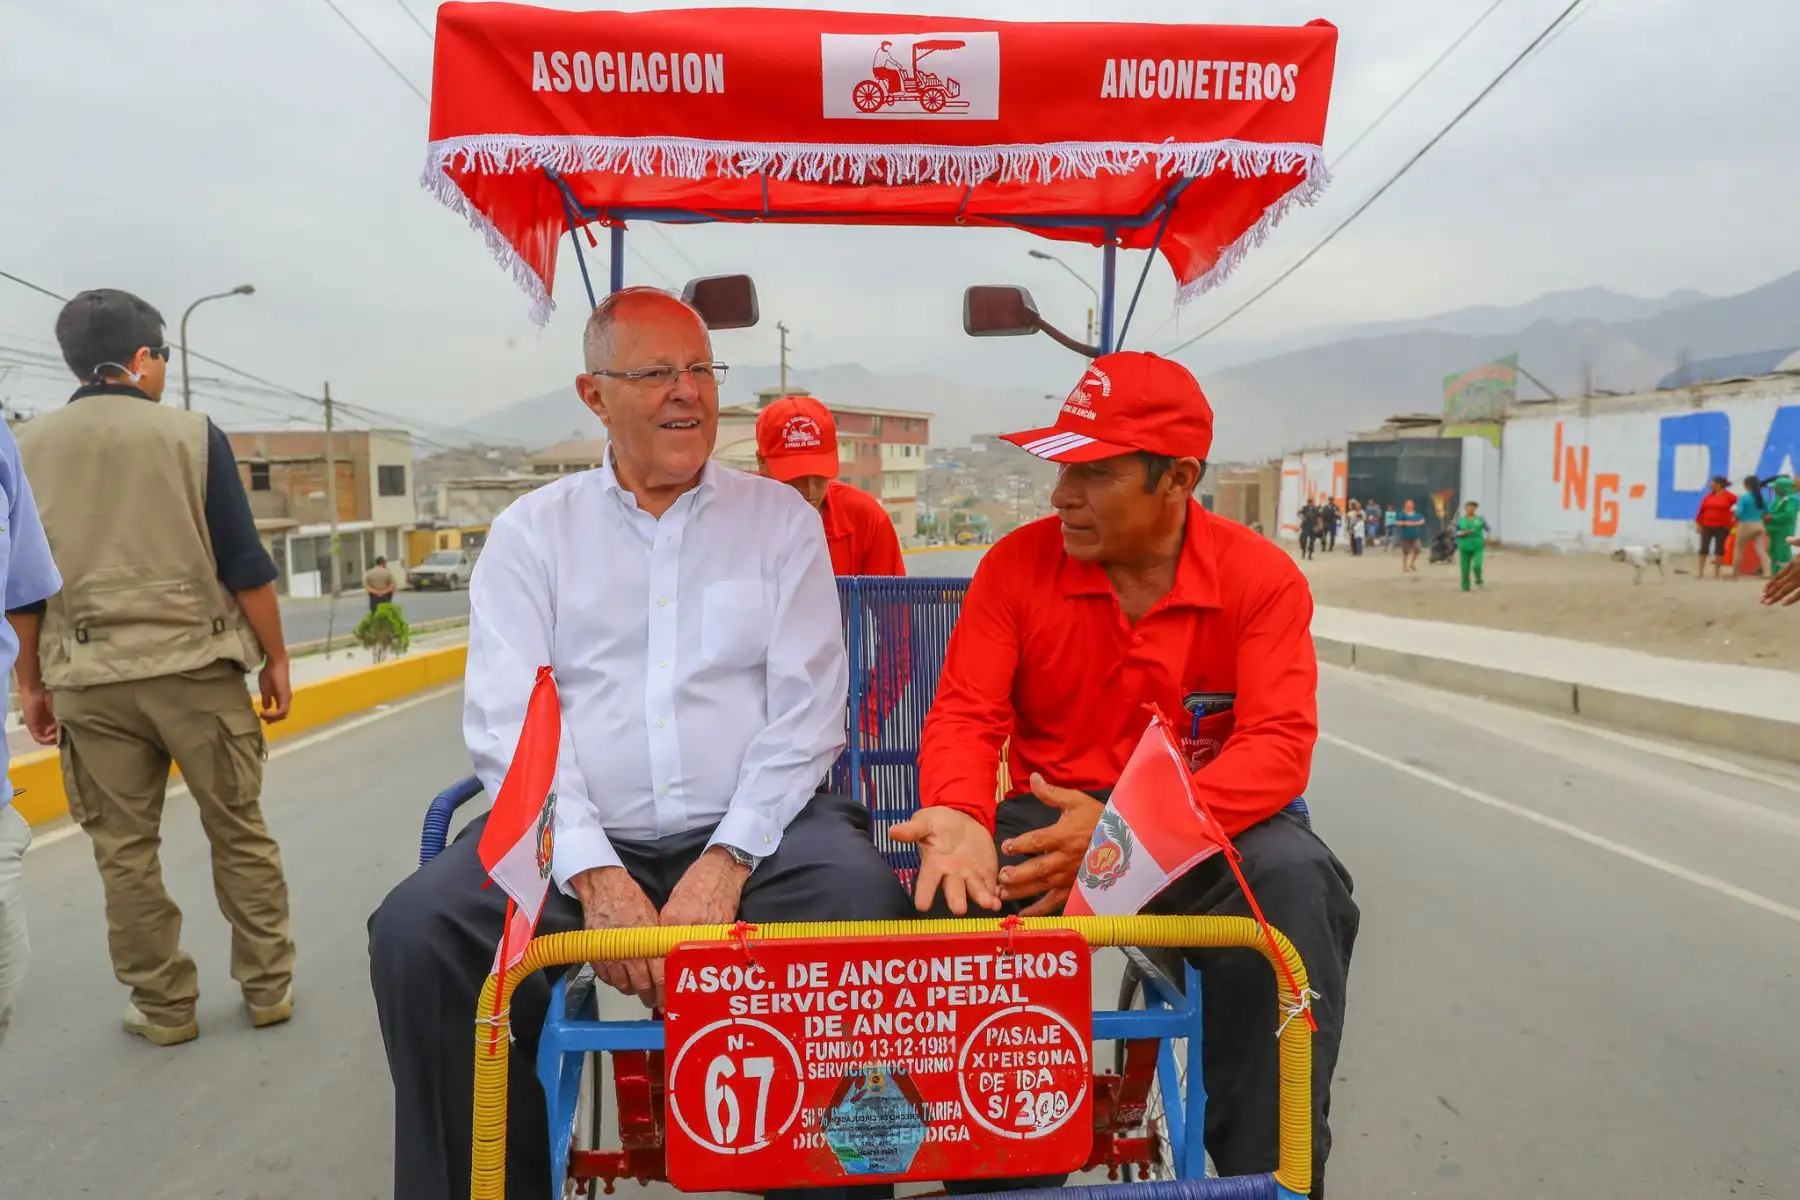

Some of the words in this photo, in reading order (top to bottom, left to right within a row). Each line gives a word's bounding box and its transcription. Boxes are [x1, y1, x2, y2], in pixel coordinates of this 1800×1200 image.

[532, 51, 725, 94] ASOCIACION
[1100, 58, 1299, 102] ANCONETEROS
[675, 965, 775, 993] ASOC.
[787, 962, 829, 988] DE
[838, 950, 1079, 986] ANCONETEROS
[729, 988, 884, 1015] SERVICIO
[895, 987, 916, 1008] A
[927, 984, 1029, 1007] PEDAL
[804, 1015, 843, 1038] DE
[852, 1010, 957, 1037] ANCON
[986, 1024, 1061, 1047] PASAJE
[805, 1039, 864, 1061] FUNDO
[972, 1052, 986, 1068] X
[989, 1048, 1076, 1068] PERSONA
[808, 1061, 871, 1080] SERVICIO
[881, 1057, 955, 1077] NOCTURNO
[980, 1071, 1006, 1093] DE
[1016, 1066, 1054, 1091] IDA
[705, 1054, 775, 1145] 67
[922, 1100, 963, 1122] TARIFA
[988, 1094, 1010, 1119] S/
[792, 1131, 828, 1150] DIO
